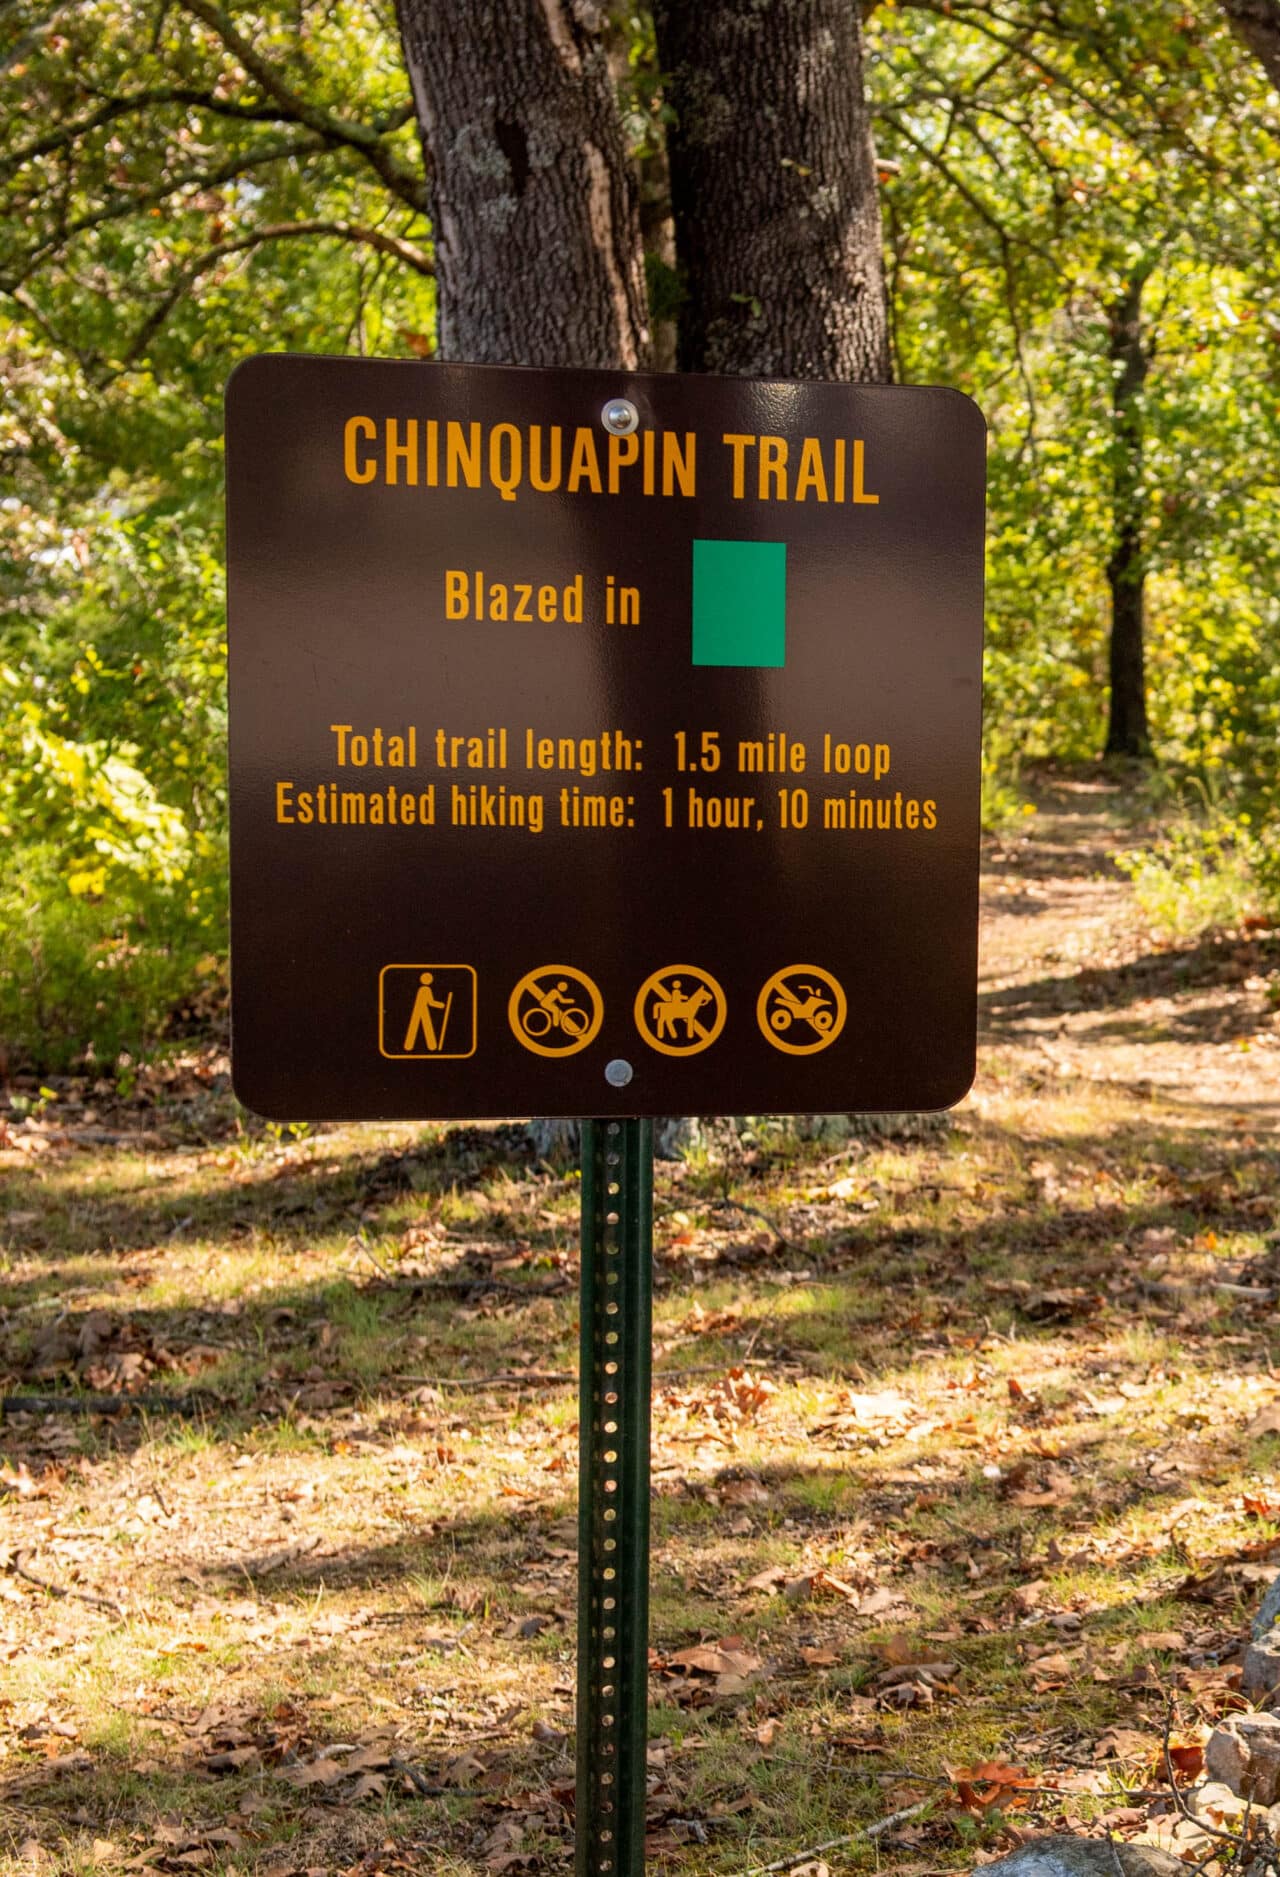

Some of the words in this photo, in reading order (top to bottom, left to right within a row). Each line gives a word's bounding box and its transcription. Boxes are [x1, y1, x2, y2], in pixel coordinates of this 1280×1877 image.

[344, 416, 698, 502] CHINQUAPIN
[723, 434, 880, 505] TRAIL
[444, 569, 584, 625] Blazed
[606, 575, 640, 625] in
[330, 723, 417, 769] Total
[434, 726, 508, 770] trail
[525, 727, 643, 780] length:
[675, 731, 721, 773] 1.5
[738, 732, 807, 774] mile
[823, 732, 891, 781] loop
[276, 780, 435, 826] Estimated
[451, 783, 544, 834] hiking
[559, 785, 635, 827] time:
[663, 787, 673, 828] 1
[688, 787, 763, 833] hour,
[777, 788, 809, 830] 10
[823, 788, 938, 832] minutes
